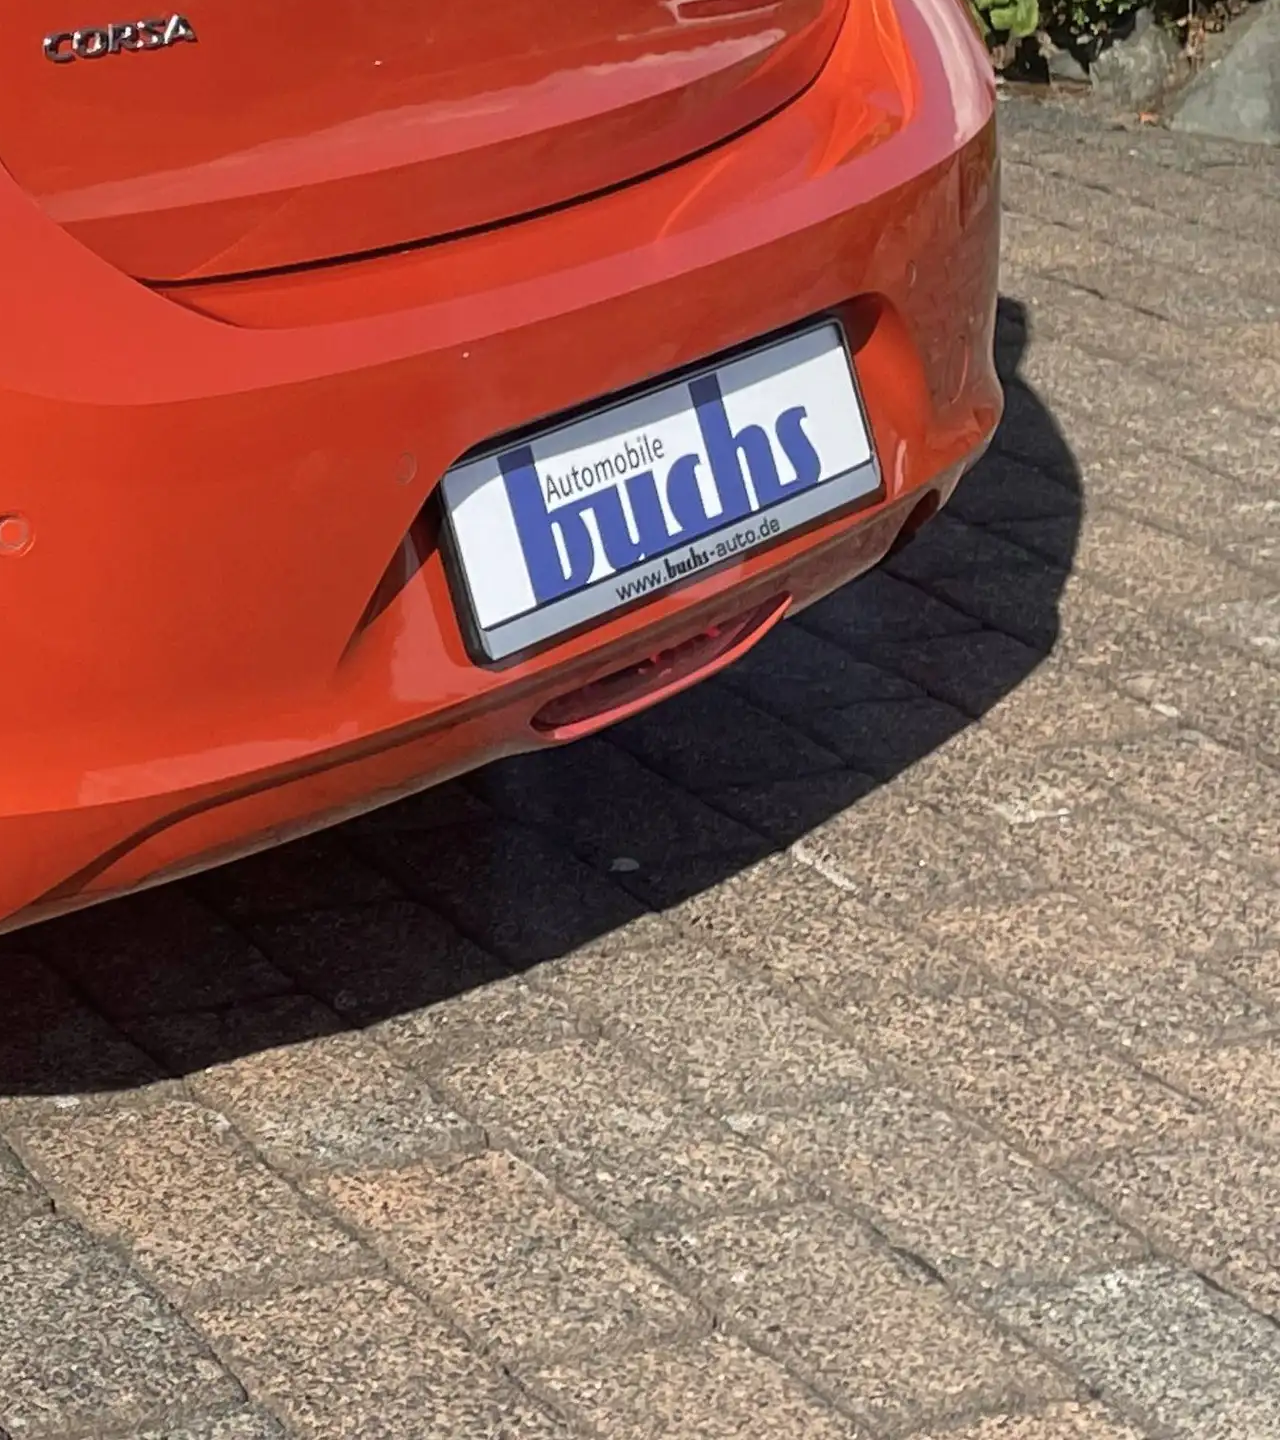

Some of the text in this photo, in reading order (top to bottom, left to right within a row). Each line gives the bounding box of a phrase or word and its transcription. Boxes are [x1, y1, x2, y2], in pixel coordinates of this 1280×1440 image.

[42, 13, 198, 63] CORSA
[497, 373, 823, 606] buchs
[545, 433, 665, 504] Automobile
[615, 516, 781, 602] www.buchs-auto.de
